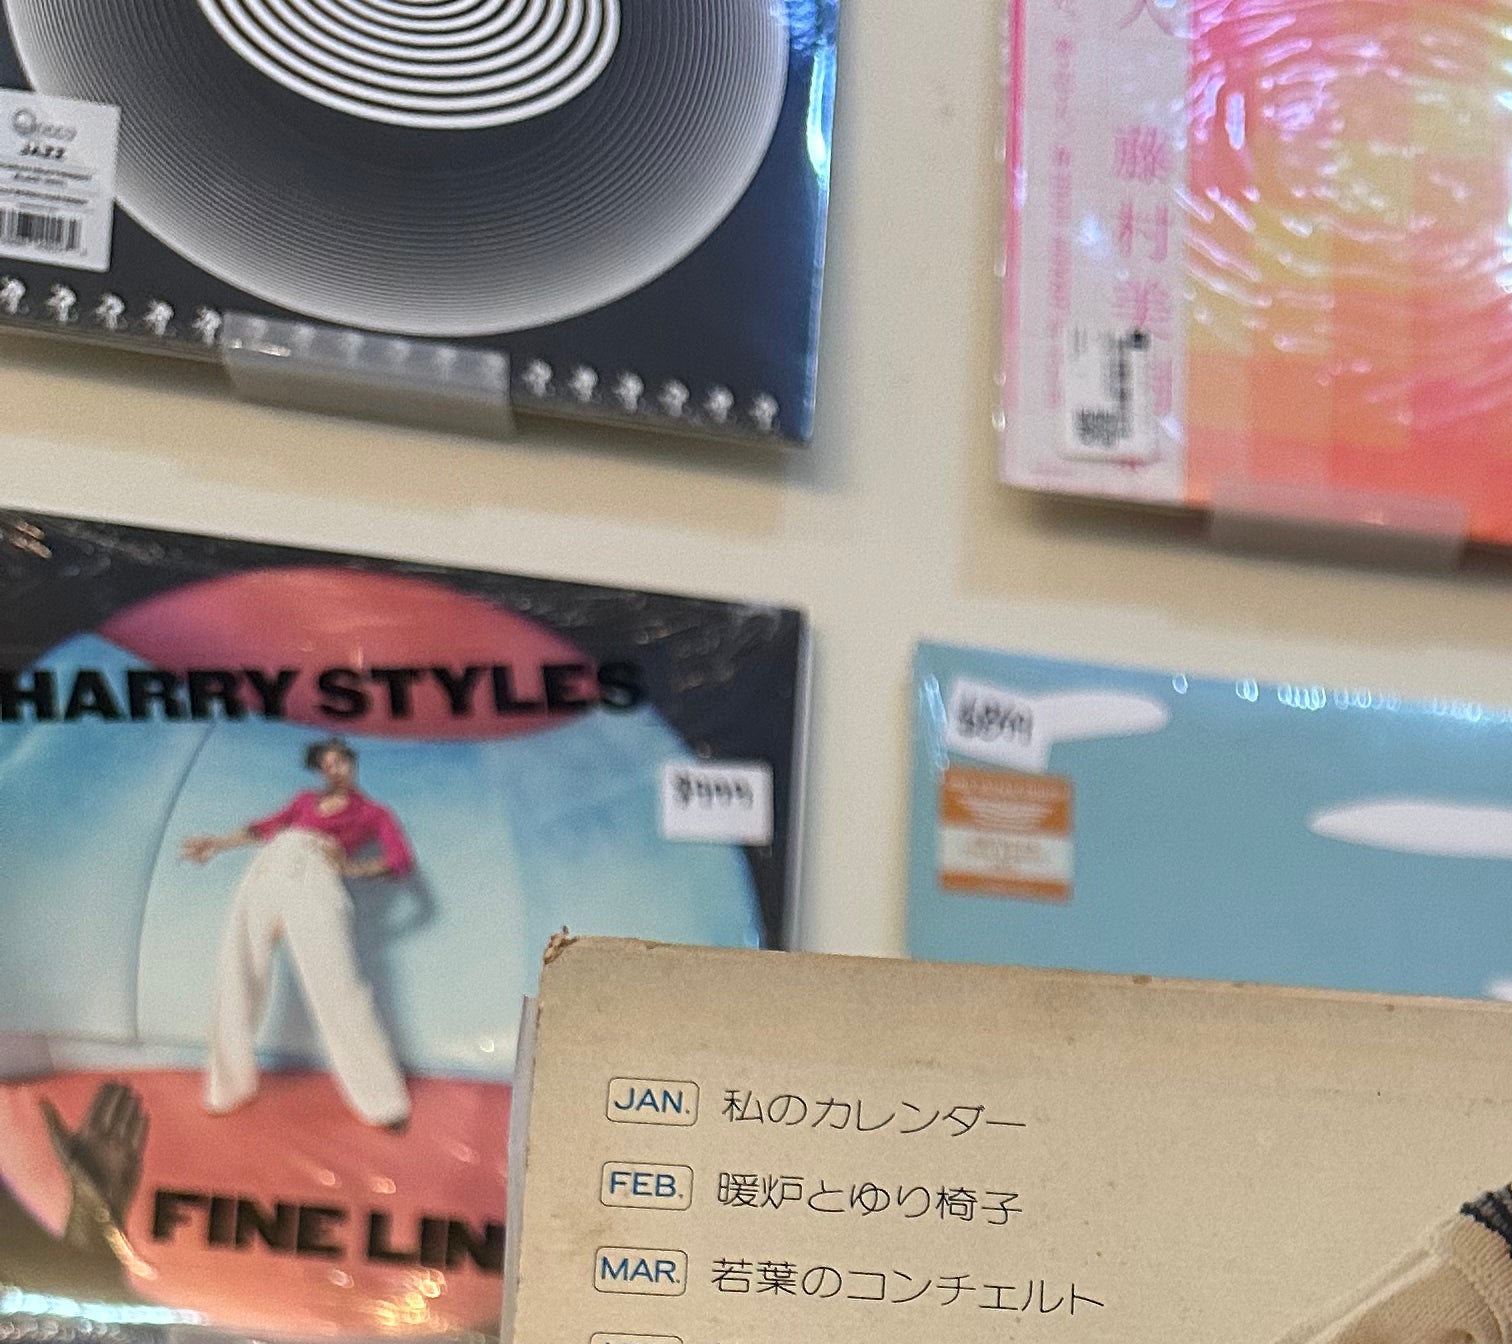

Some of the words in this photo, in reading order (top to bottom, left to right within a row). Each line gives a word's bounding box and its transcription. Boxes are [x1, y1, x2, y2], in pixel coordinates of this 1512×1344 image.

[2, 667, 297, 724] HARRY
[316, 660, 648, 719] STYLES
[613, 1088, 691, 1115] JAN.
[721, 1088, 1028, 1137] 私のカレンダー
[149, 1188, 347, 1258] FINE
[608, 1171, 684, 1199] FEB.
[716, 1172, 1023, 1225] 暖炉とゆり椅子
[600, 1256, 681, 1284] MAR.
[710, 1258, 1105, 1316] 若葉のコンチェルト
